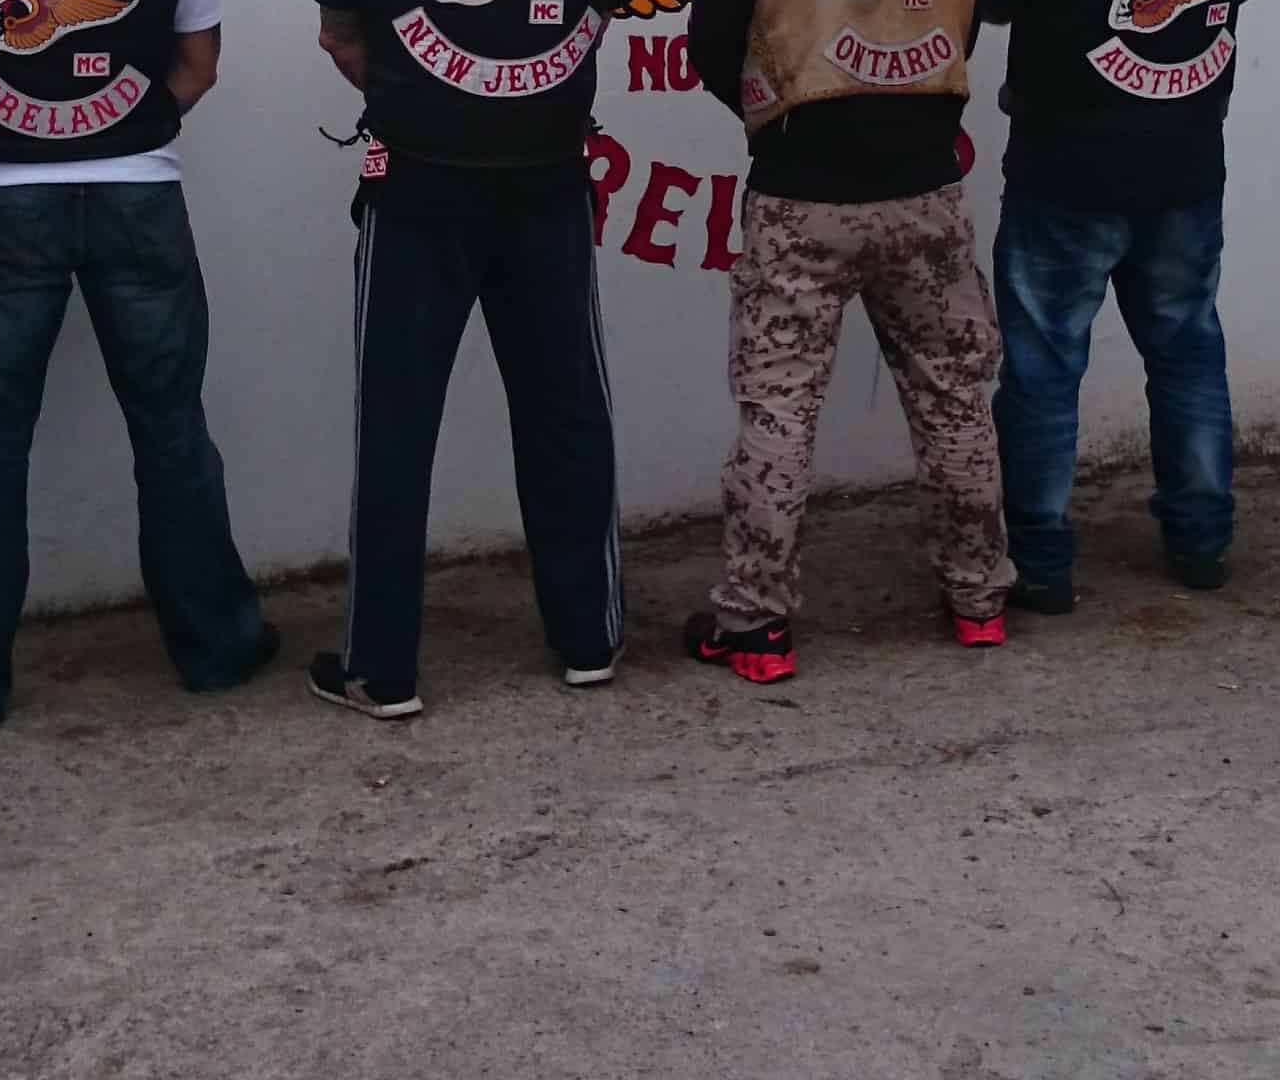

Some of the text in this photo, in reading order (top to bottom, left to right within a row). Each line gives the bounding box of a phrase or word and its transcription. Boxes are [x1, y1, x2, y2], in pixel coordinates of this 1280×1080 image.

[533, 3, 559, 20] MC
[1208, 6, 1227, 23] MC
[76, 56, 107, 73] MC
[400, 16, 475, 85] NEW
[483, 15, 594, 94] JERSEY
[835, 34, 952, 80] ONTARIO
[1095, 38, 1232, 95] AUSTRALIA
